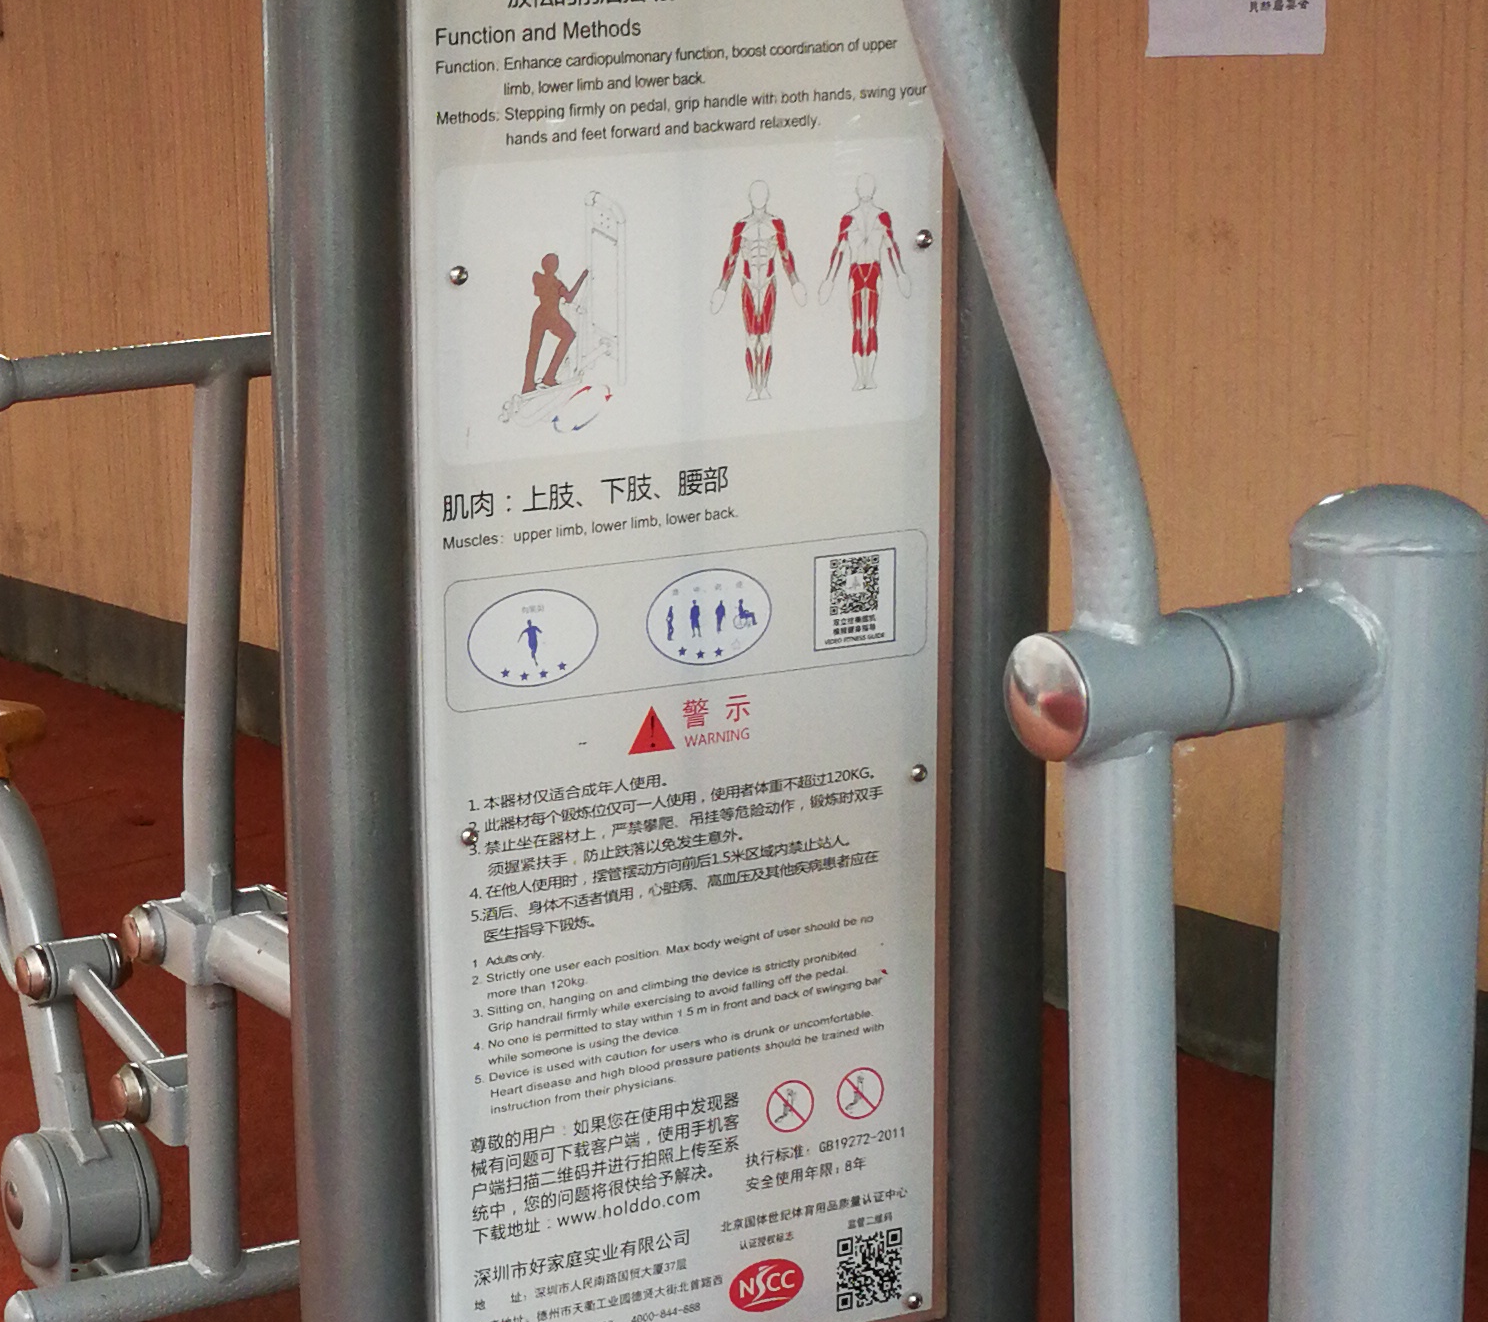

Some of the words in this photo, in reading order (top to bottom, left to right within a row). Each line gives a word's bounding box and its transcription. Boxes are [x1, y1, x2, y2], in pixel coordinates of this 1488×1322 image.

[435, 26, 515, 45] Function
[522, 22, 556, 41] and
[562, 18, 641, 38] Methods
[504, 56, 562, 70] Enhance
[565, 51, 672, 67] cardiopulmonary
[675, 47, 728, 60] function,
[732, 44, 766, 57] boost
[769, 42, 843, 55] coordination
[847, 38, 859, 51] of
[862, 39, 896, 52] upper
[503, 81, 534, 95] limb,
[538, 80, 573, 93] lower
[576, 77, 604, 90] limb
[606, 75, 631, 89] and
[634, 75, 670, 87] lower
[672, 71, 705, 85] back.
[436, 109, 499, 124] Methods:
[504, 106, 565, 121] Stepping
[568, 102, 605, 118] firmly
[609, 103, 626, 114] on
[630, 98, 670, 115] pedal,
[674, 98, 700, 113] grip
[703, 94, 747, 107] handle
[751, 93, 777, 104] with
[780, 90, 809, 103] both
[813, 88, 855, 101] hands,
[859, 87, 896, 100] swing
[900, 85, 927, 98] your
[506, 130, 547, 145] hands
[551, 128, 576, 142] and
[581, 127, 606, 140] feet
[610, 123, 660, 138] forward
[664, 121, 689, 135] and
[693, 117, 755, 133] backward
[442, 534, 504, 549] Muscles:
[513, 528, 551, 543] upper
[556, 523, 586, 536] limb,
[592, 520, 626, 533] lower
[631, 515, 660, 528] limb,
[666, 512, 700, 524] lower
[704, 506, 738, 520] back.
[684, 727, 751, 749] WARNING
[486, 969, 526, 982] Strictly
[528, 966, 551, 976] one
[554, 961, 580, 972] user
[583, 955, 611, 967] each
[666, 944, 690, 954] Max
[692, 939, 721, 950] body
[762, 929, 774, 939] of
[776, 927, 800, 937] user
[804, 919, 840, 932] should
[860, 915, 874, 923] no
[520, 950, 544, 961] only.
[487, 988, 516, 998] more
[520, 983, 545, 993] than
[487, 1021, 513, 1032] Grip
[516, 1012, 563, 1027] handrail
[566, 1007, 598, 1019] firmly
[600, 1002, 630, 1013] while
[633, 993, 691, 1008] exercising
[694, 990, 705, 998] to
[708, 983, 738, 996] avoid
[741, 979, 774, 990] falling
[777, 974, 792, 985] off
[815, 965, 848, 980] pedal.
[488, 1053, 517, 1064] while
[520, 1045, 573, 1059] someone
[576, 1042, 586, 1050] is
[588, 1037, 619, 1048] using
[490, 1097, 550, 1113] instruction
[554, 1092, 580, 1102] from
[584, 1086, 609, 1097] their
[614, 1077, 676, 1094] physicians.
[473, 1228, 690, 1288] 深圳市好家庭实业有限公司
